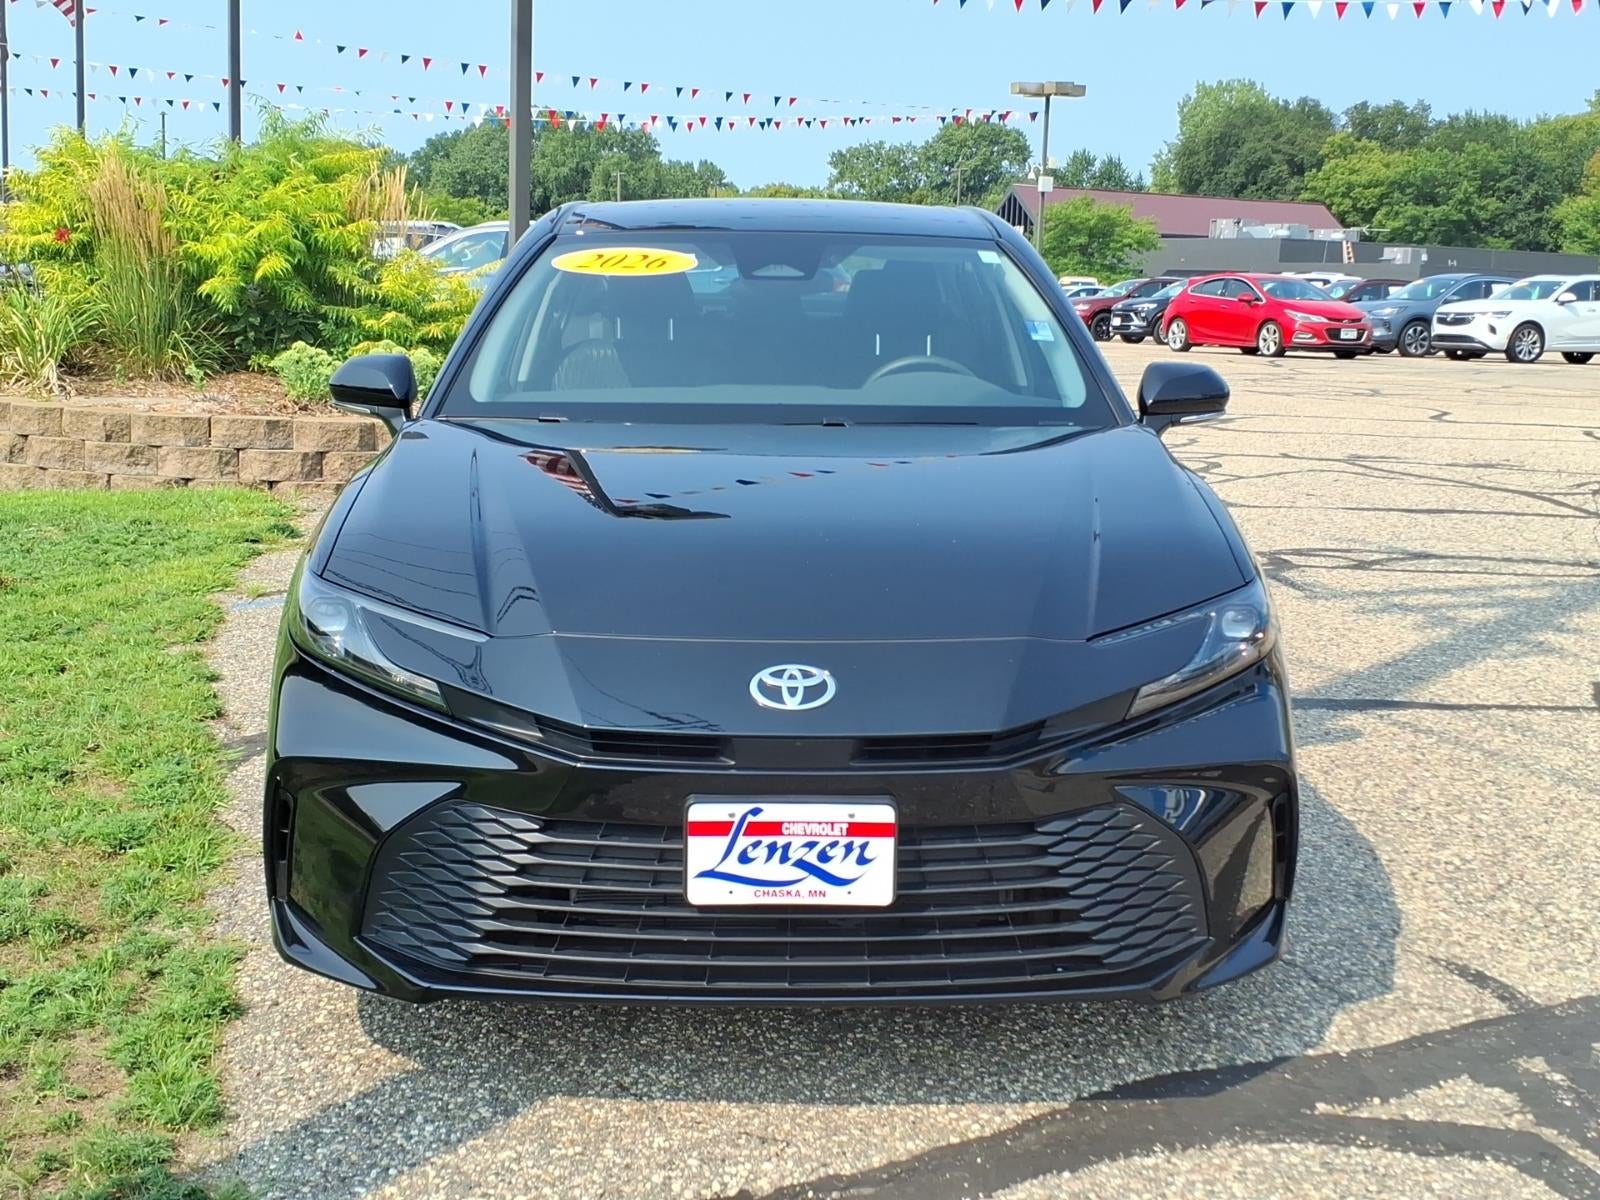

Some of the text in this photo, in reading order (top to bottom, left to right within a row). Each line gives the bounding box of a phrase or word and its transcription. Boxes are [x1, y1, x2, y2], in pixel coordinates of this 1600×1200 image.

[575, 254, 667, 269] 2026
[781, 822, 849, 837] CHEVROLET
[693, 806, 878, 887] Lenzen
[753, 889, 827, 899] CHASKA, MN
